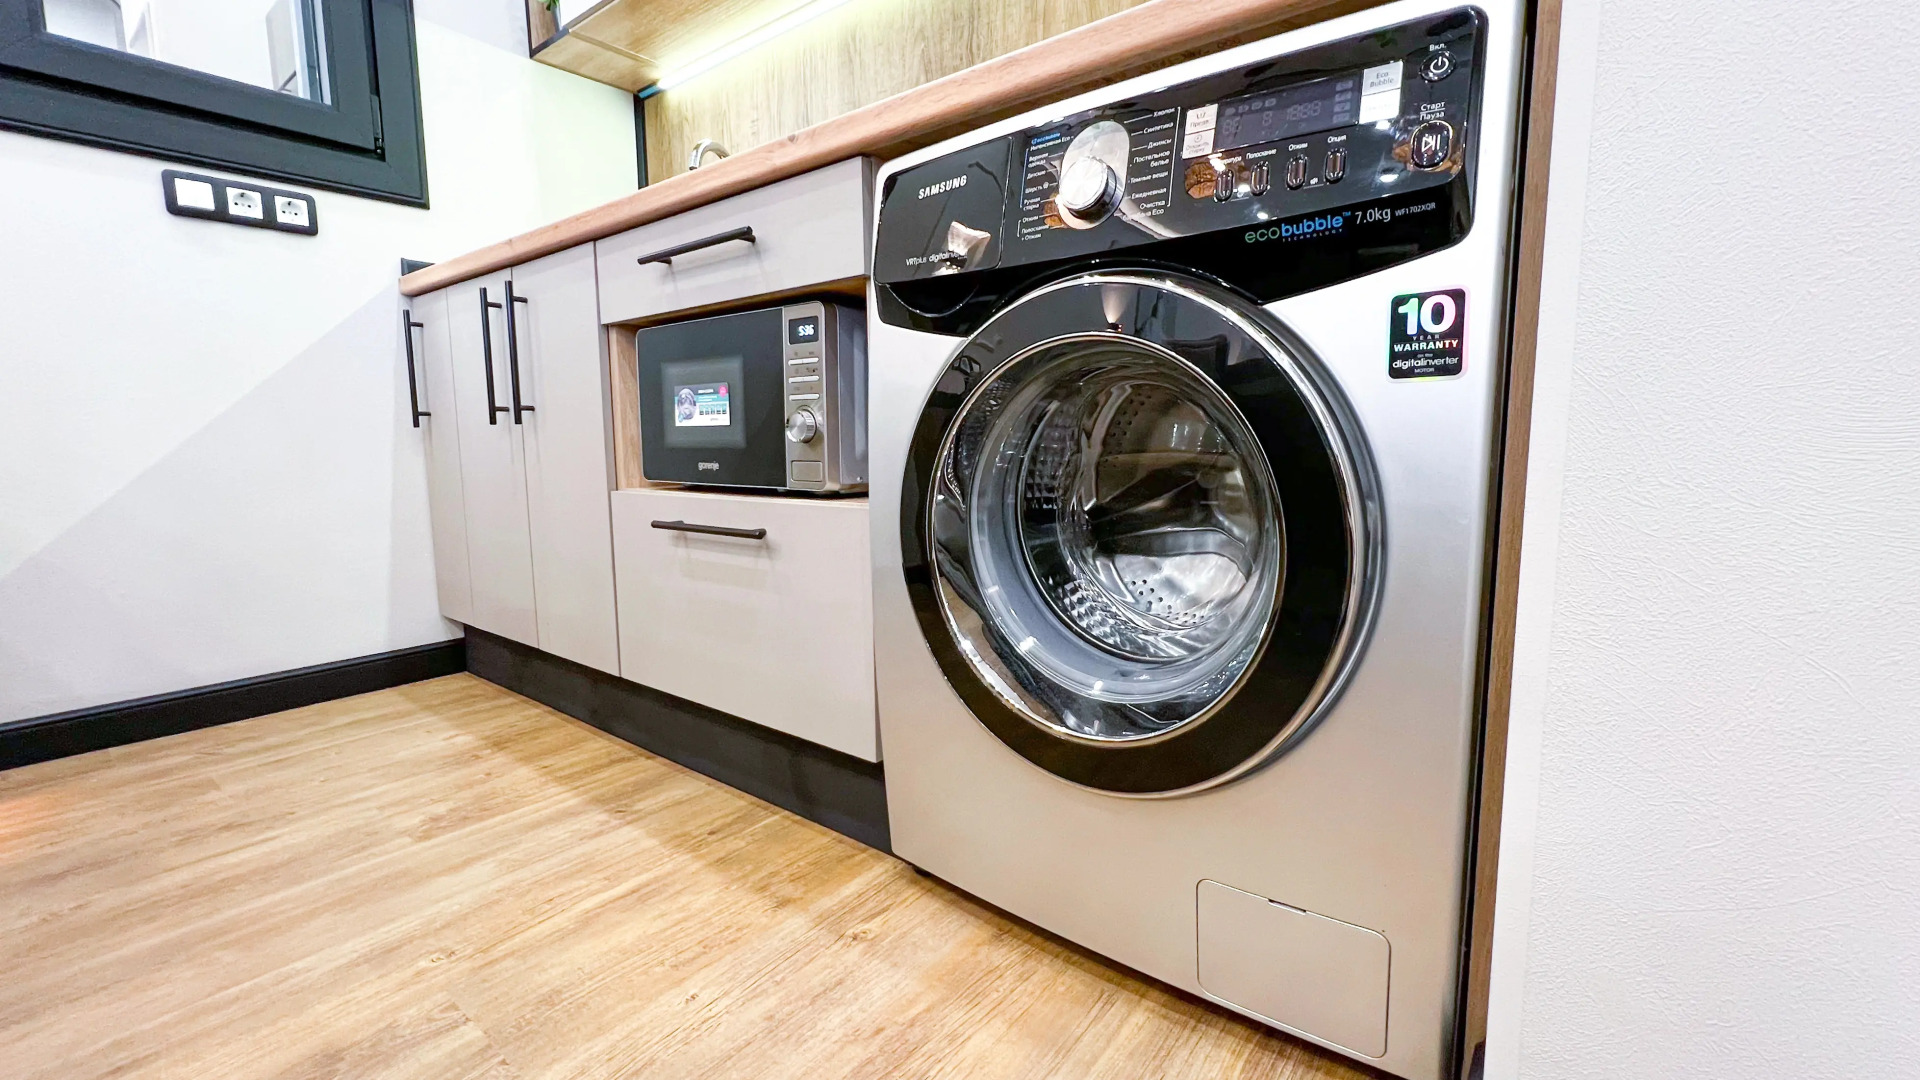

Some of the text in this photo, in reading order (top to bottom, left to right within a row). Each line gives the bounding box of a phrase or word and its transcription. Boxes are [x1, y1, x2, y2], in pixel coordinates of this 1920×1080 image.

[1429, 43, 1447, 51] Вкл.
[1376, 71, 1389, 79] Eco
[1369, 77, 1394, 88] Bubble
[1420, 101, 1446, 112] Старт
[1420, 111, 1445, 121] Пауза
[1133, 150, 1170, 164] Постельное
[918, 174, 968, 200] SAMSUNG
[1139, 200, 1166, 210] Очистка
[1151, 208, 1165, 216] Eco
[1355, 207, 1391, 225] 7.0kg
[1282, 227, 1344, 243] TECHNOLOGY
[1398, 294, 1456, 335] 10
[1393, 340, 1458, 352] WARRANTY
[1392, 356, 1459, 370] digitalinverter
[697, 461, 720, 471] gorenje
